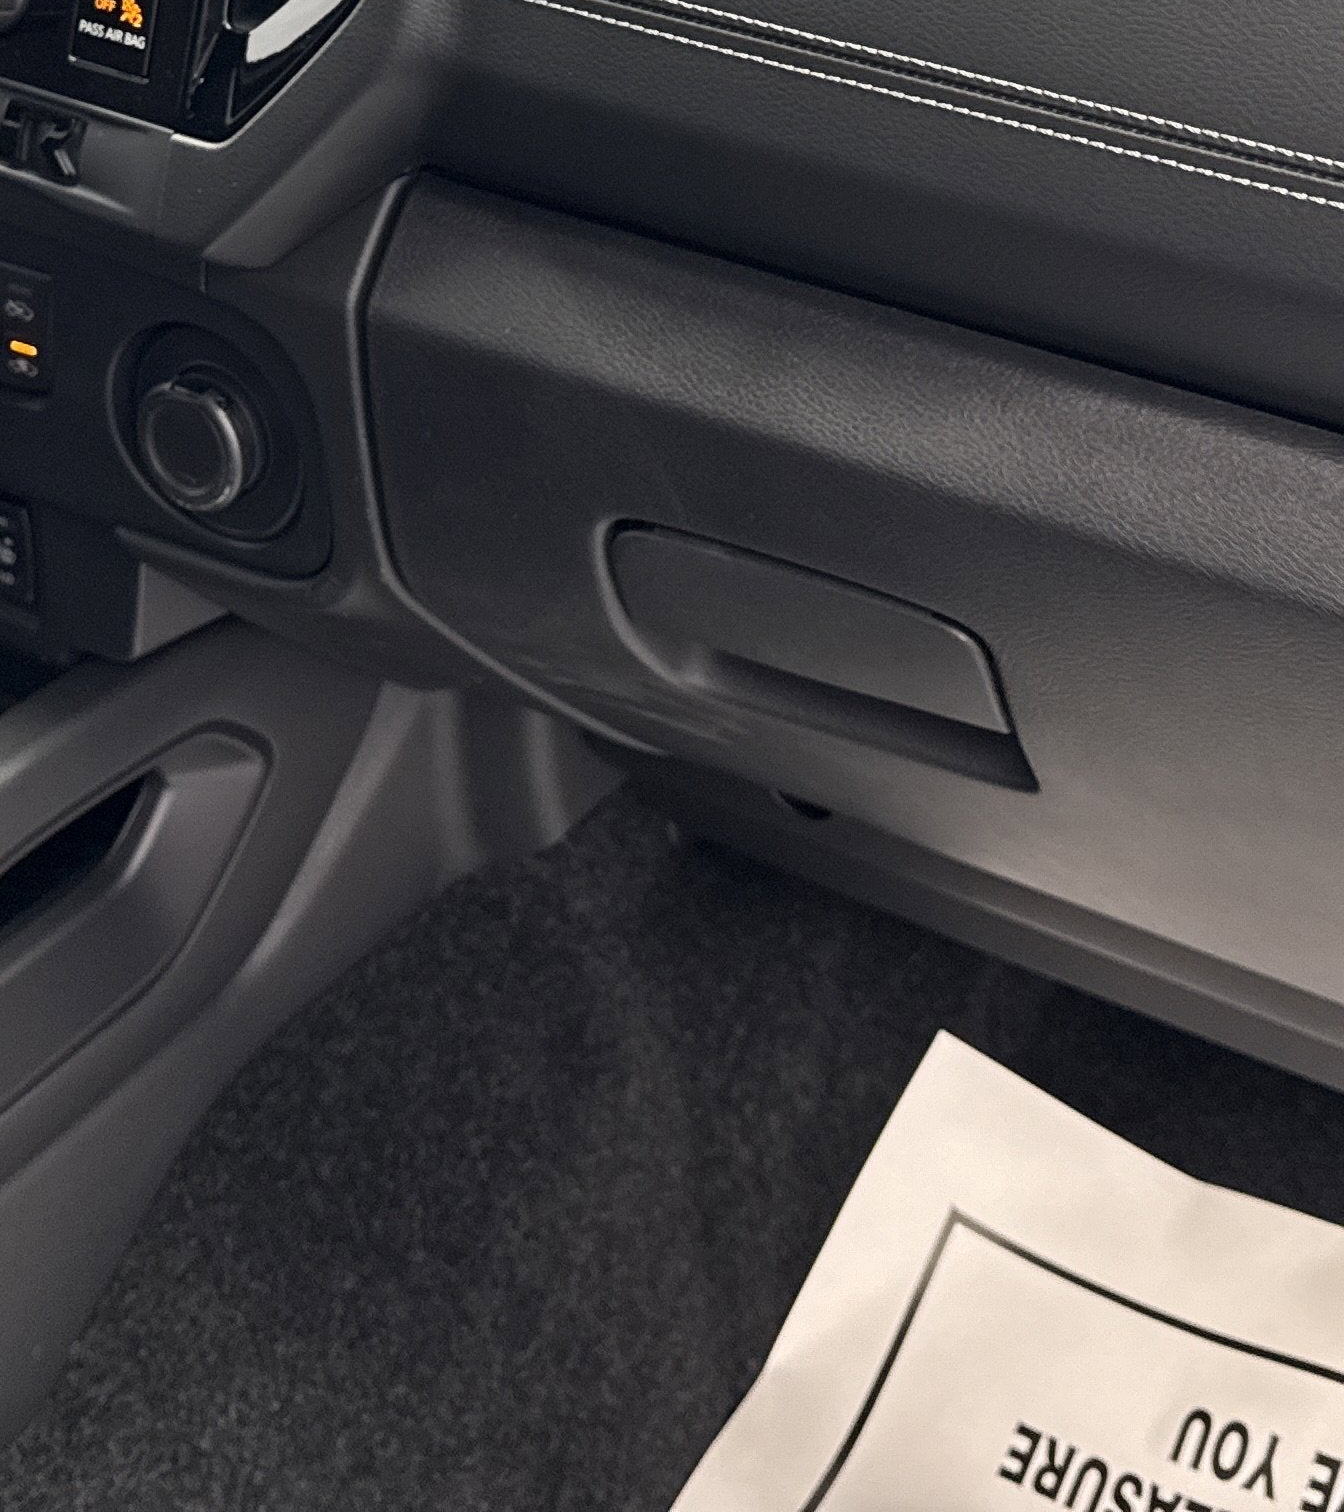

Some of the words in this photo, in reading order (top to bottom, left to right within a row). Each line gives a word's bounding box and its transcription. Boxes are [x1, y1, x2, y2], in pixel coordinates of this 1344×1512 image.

[78, 18, 106, 38] PASS
[105, 26, 124, 43] AIR
[123, 31, 146, 50] BAG
[997, 1421, 1231, 1512] ASURE
[1170, 1408, 1280, 1500] YOU
